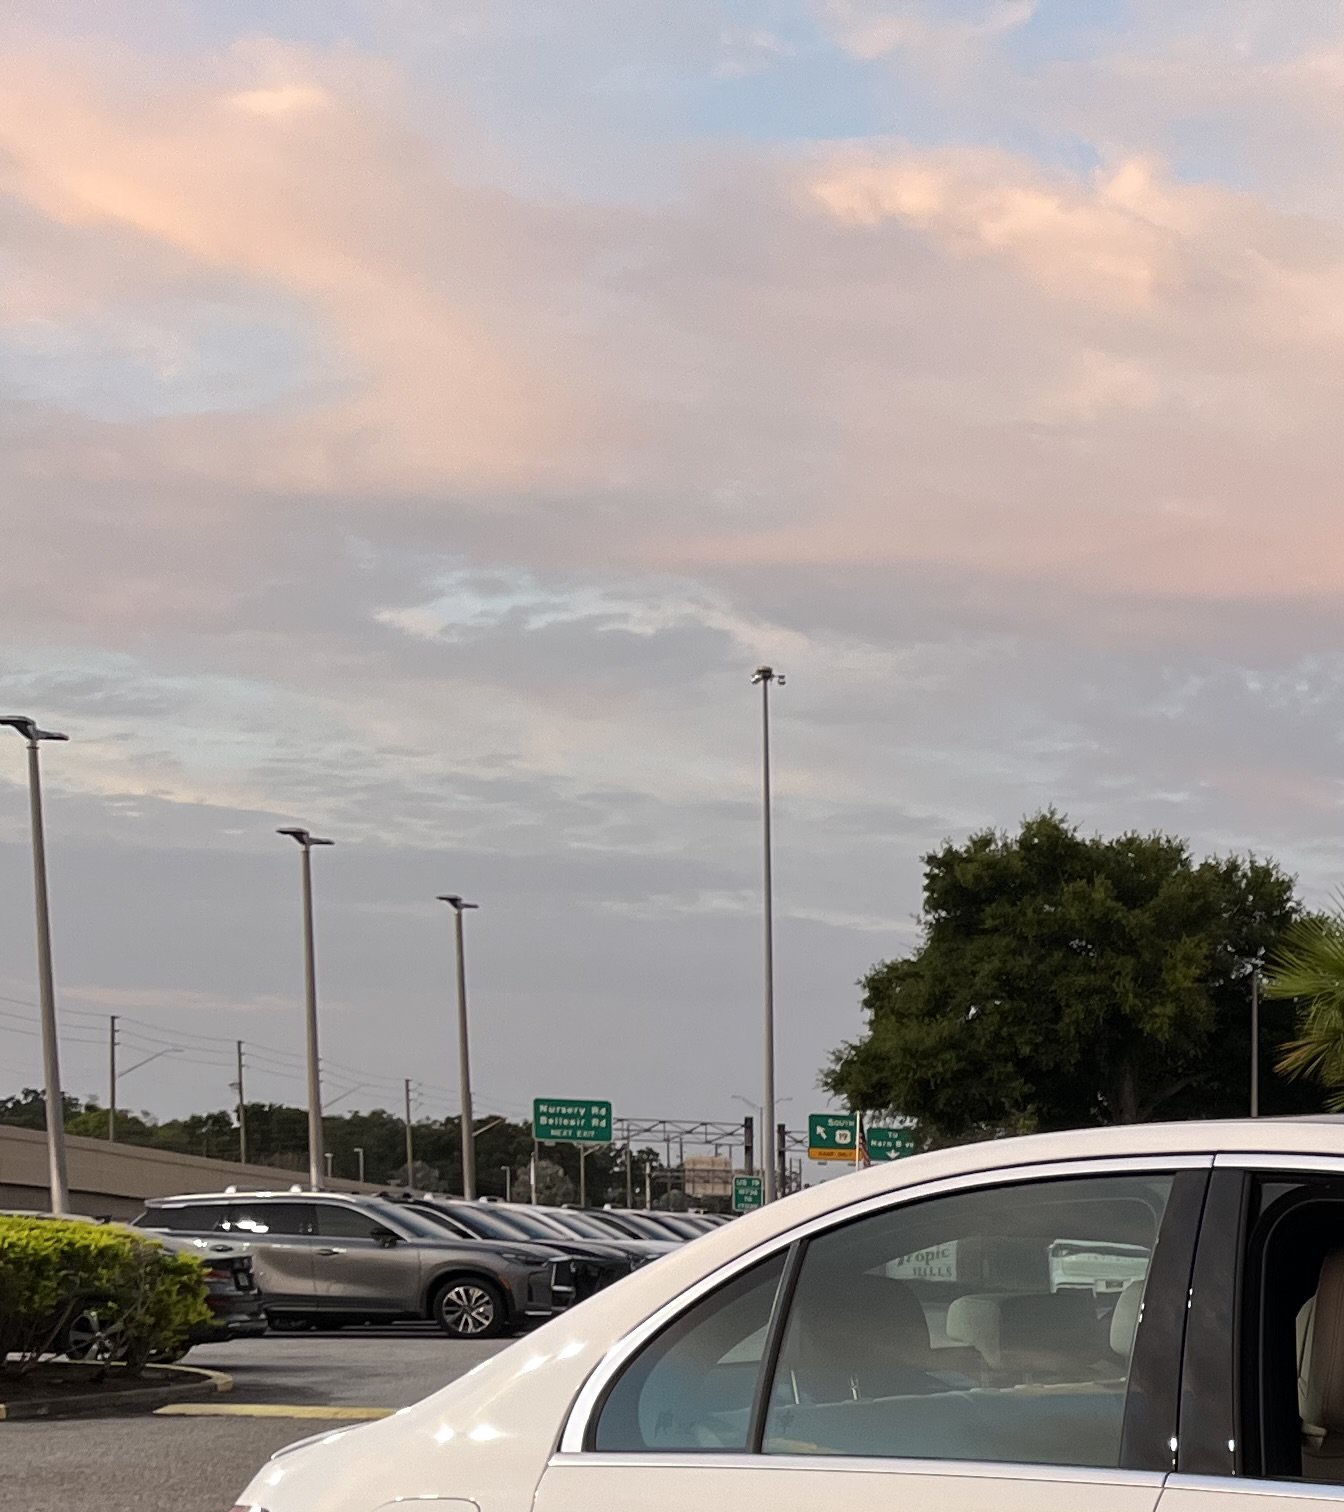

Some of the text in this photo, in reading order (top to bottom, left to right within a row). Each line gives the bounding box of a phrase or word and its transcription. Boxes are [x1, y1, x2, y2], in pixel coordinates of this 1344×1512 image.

[539, 1104, 607, 1116] Nursery Rd
[591, 1117, 607, 1128] Rd
